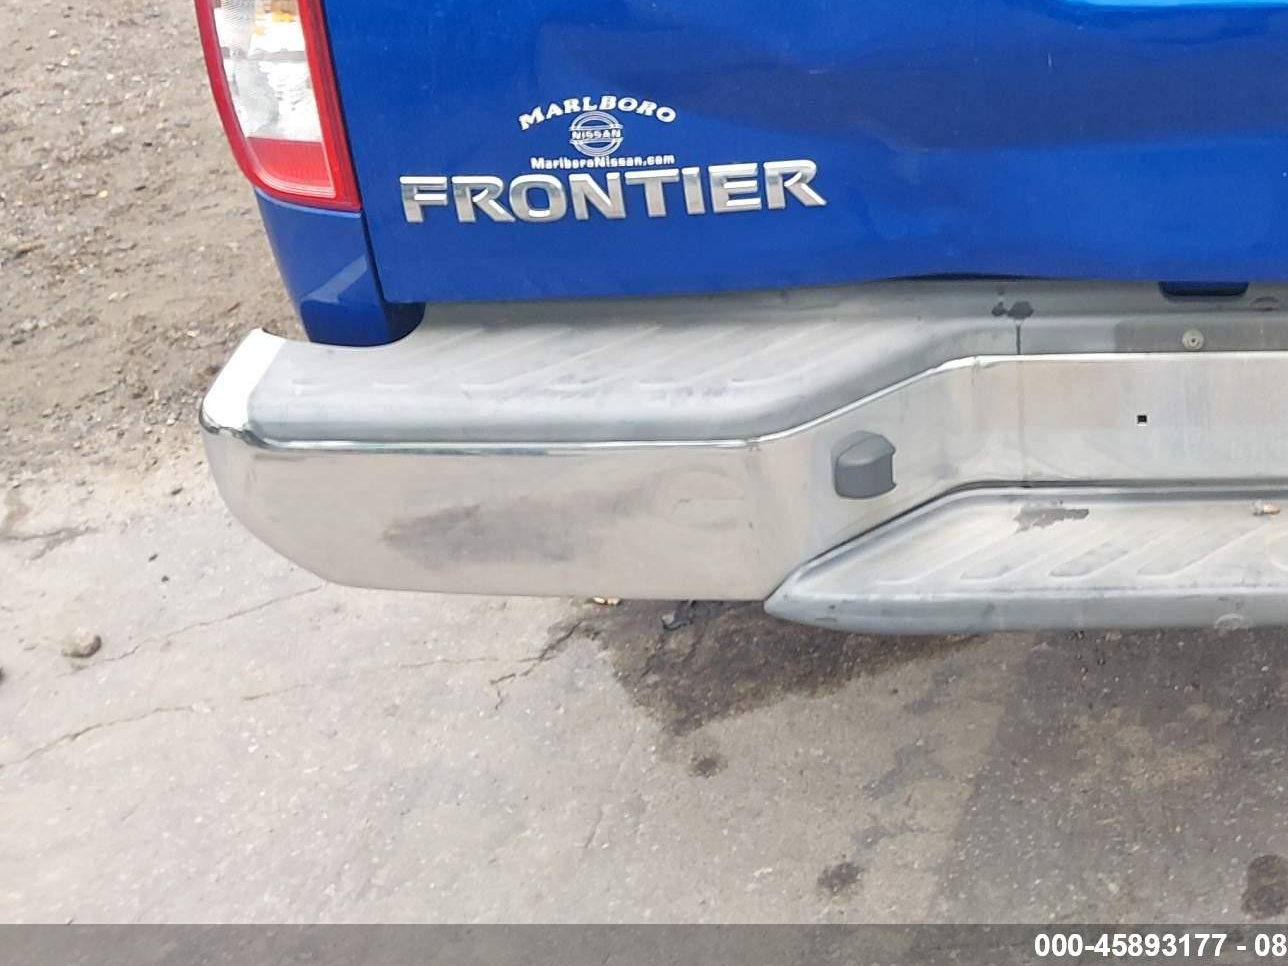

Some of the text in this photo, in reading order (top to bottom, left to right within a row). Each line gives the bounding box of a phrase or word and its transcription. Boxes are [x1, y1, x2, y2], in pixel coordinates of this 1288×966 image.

[518, 95, 677, 131] MARLBORO
[571, 128, 622, 141] NISSAN
[530, 154, 675, 170] MarlboroNissan.com
[399, 159, 827, 223] FRONTIER
